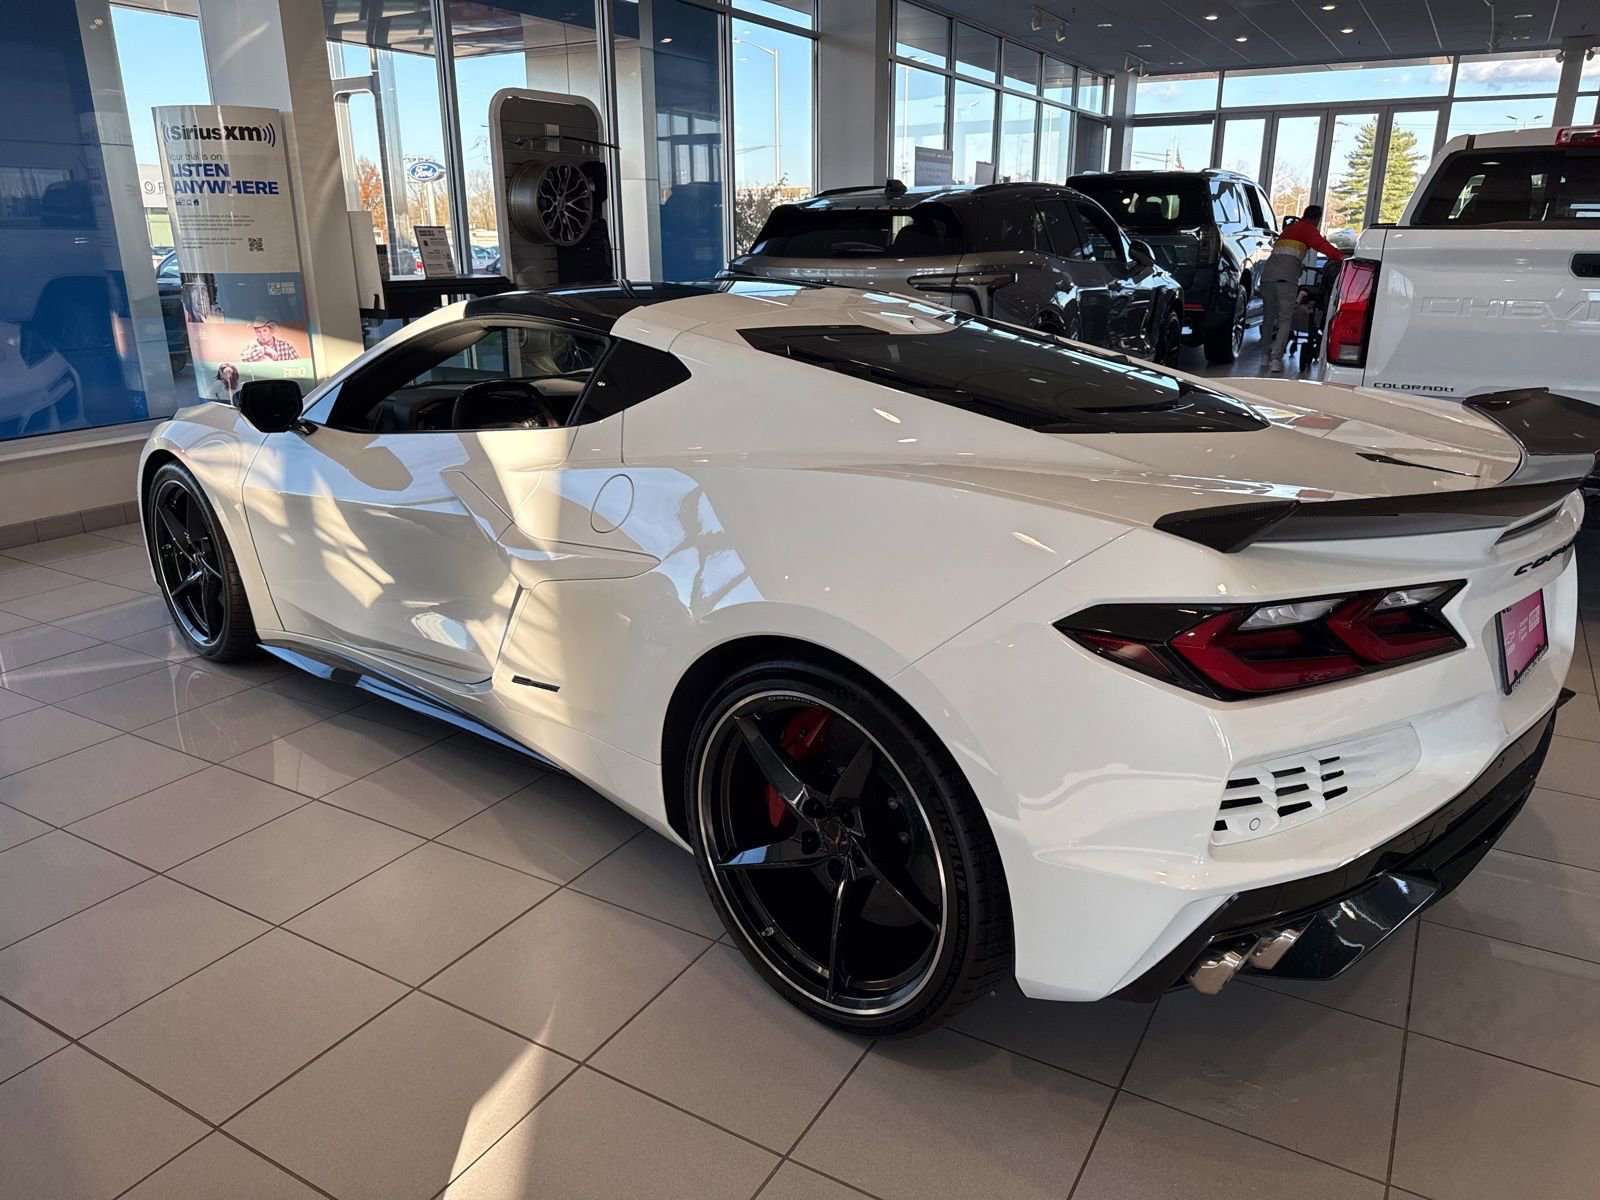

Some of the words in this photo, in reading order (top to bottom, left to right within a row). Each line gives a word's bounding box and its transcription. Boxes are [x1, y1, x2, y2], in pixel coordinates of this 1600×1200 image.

[185, 152, 199, 161] trial
[202, 153, 208, 161] is
[170, 163, 230, 177] LISTEN
[174, 180, 280, 195] ANYWHERE
[1373, 382, 1454, 392] COLORADO
